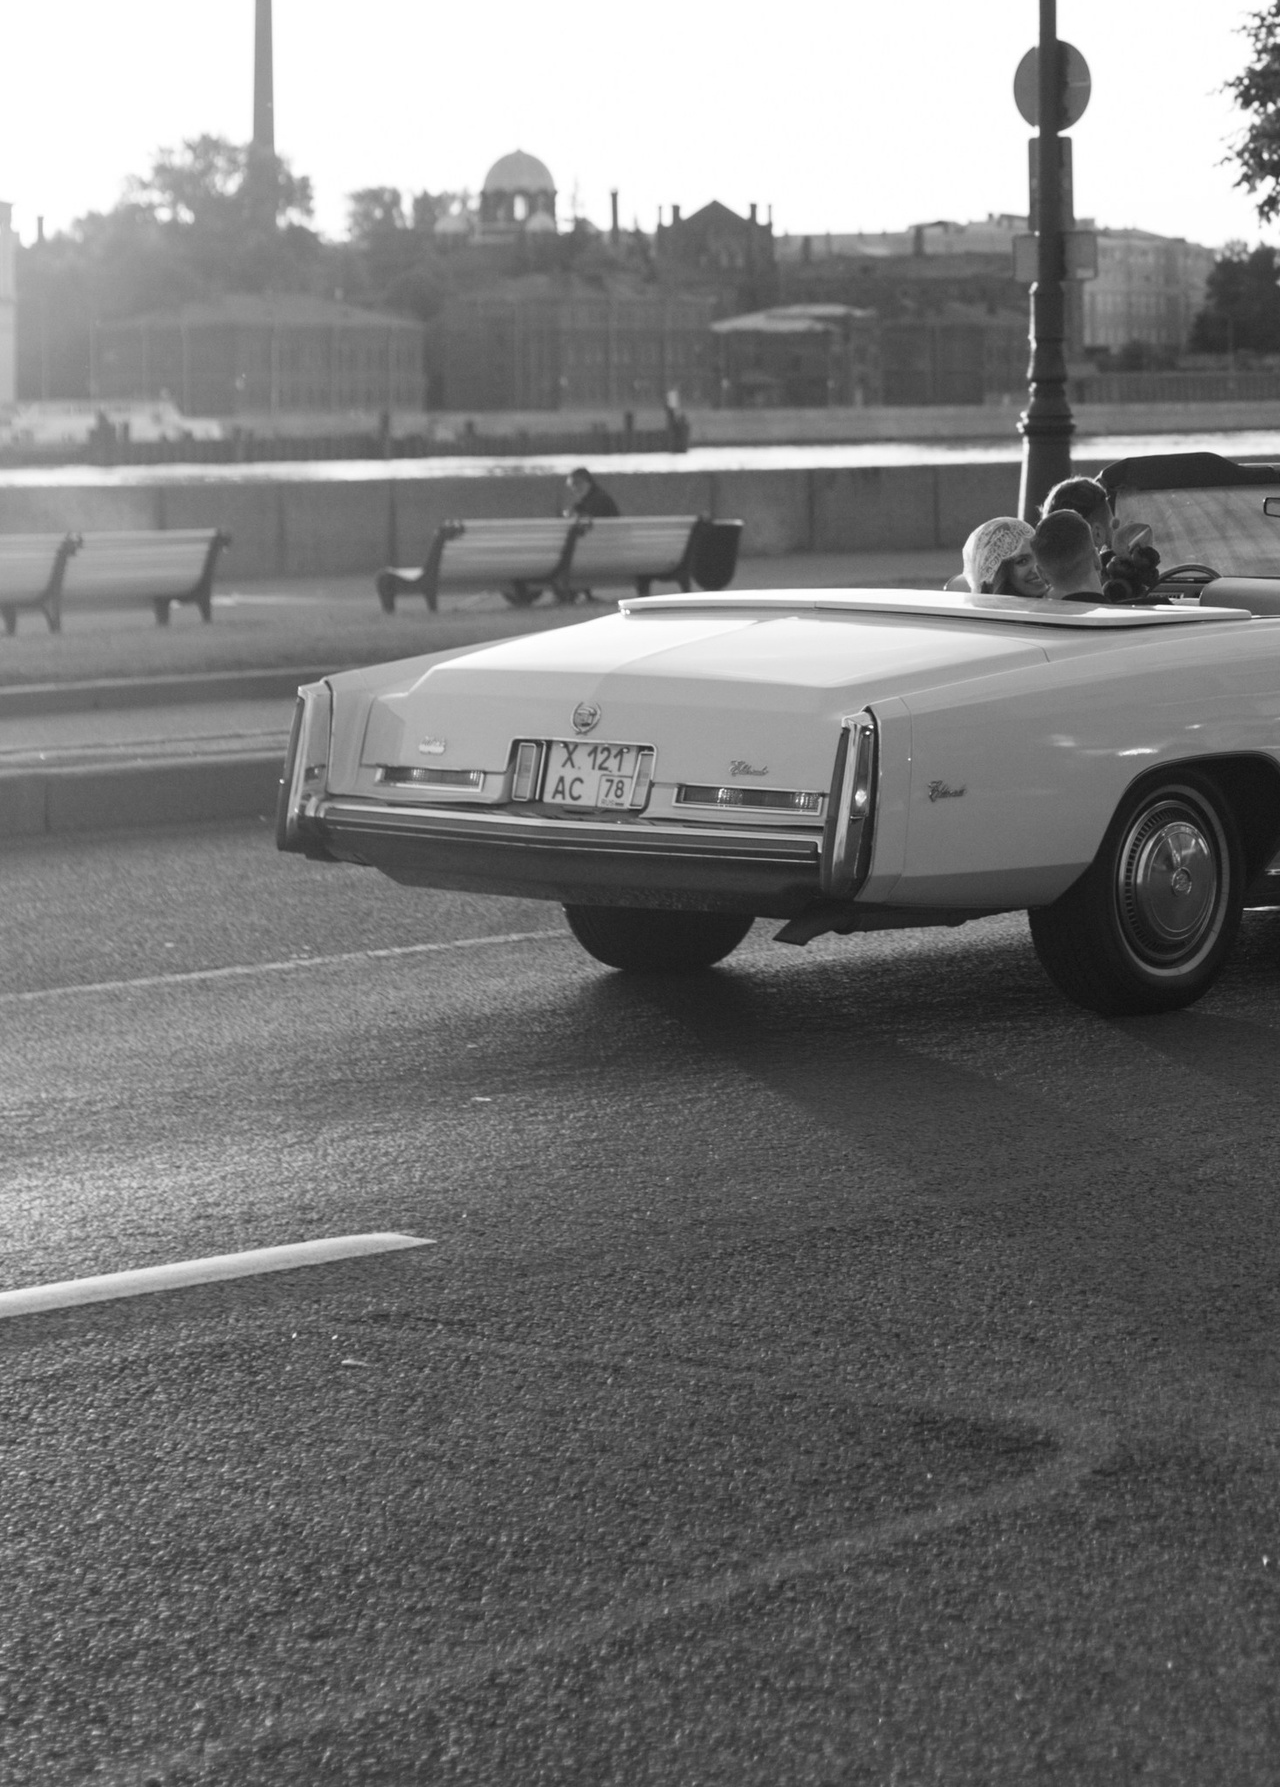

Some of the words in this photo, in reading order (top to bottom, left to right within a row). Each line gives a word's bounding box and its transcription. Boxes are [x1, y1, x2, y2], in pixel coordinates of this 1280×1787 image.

[587, 745, 624, 772] 121
[551, 775, 584, 801] AC
[604, 779, 624, 798] 78
